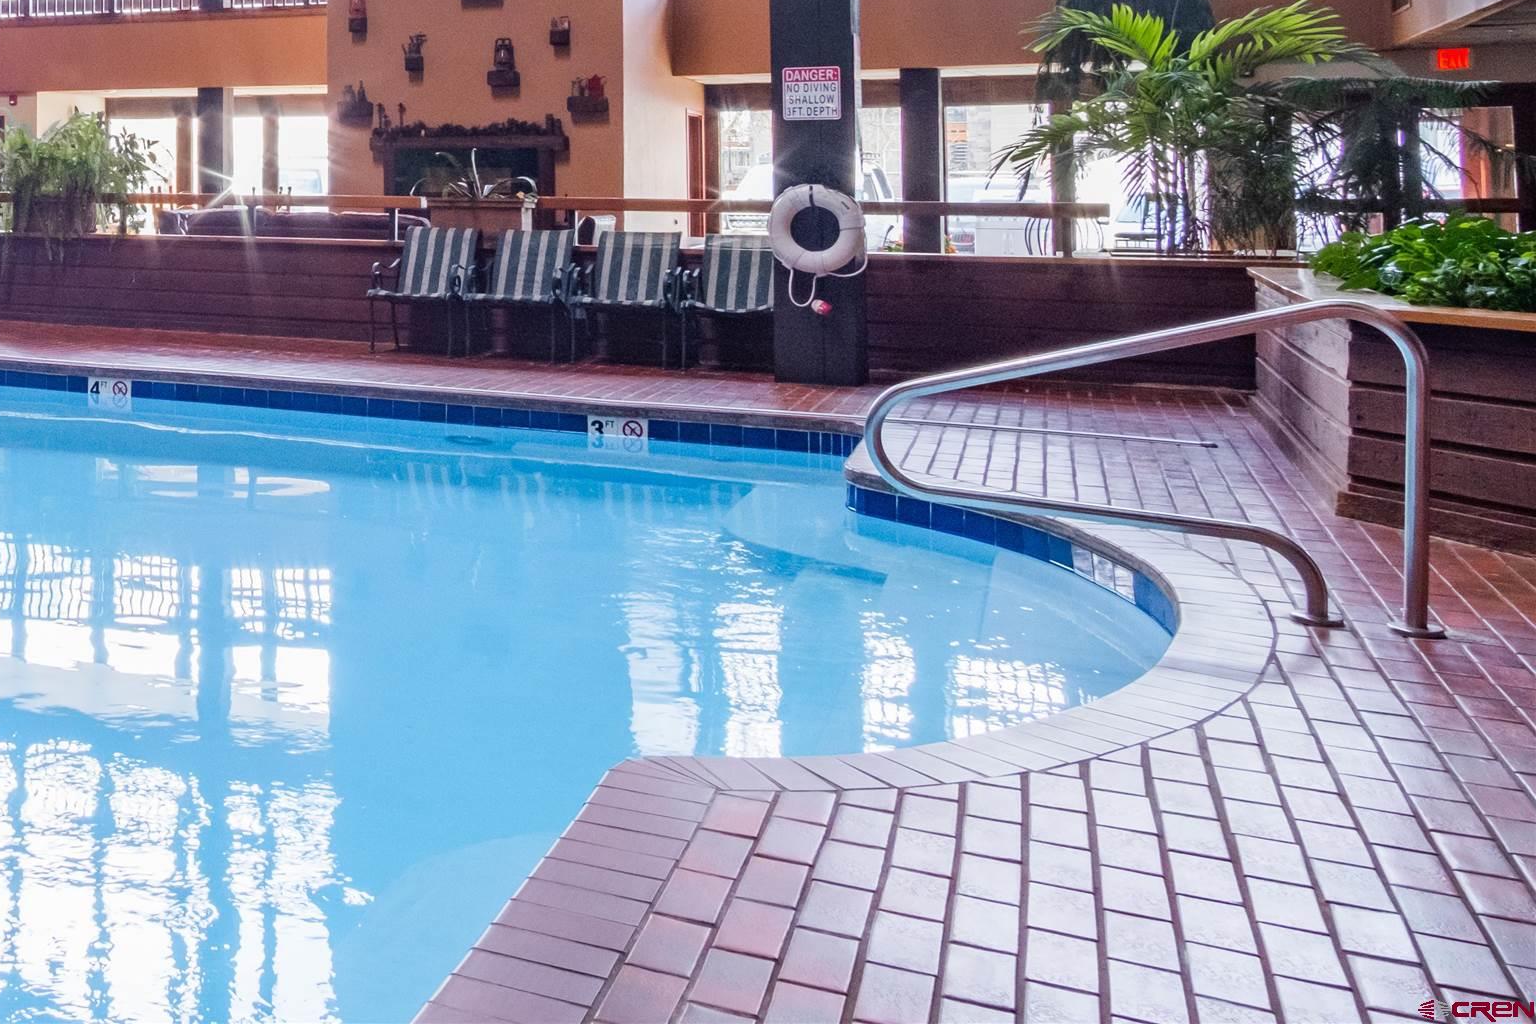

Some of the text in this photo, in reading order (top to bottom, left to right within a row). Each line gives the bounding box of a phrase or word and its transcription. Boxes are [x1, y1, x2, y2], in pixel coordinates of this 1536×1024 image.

[785, 69, 838, 82] DANGER:
[786, 82, 837, 93] NO DIVING
[789, 94, 835, 105] SHALLOW
[806, 106, 838, 117] DEPTH
[90, 380, 100, 394] 4
[605, 420, 615, 428] FT
